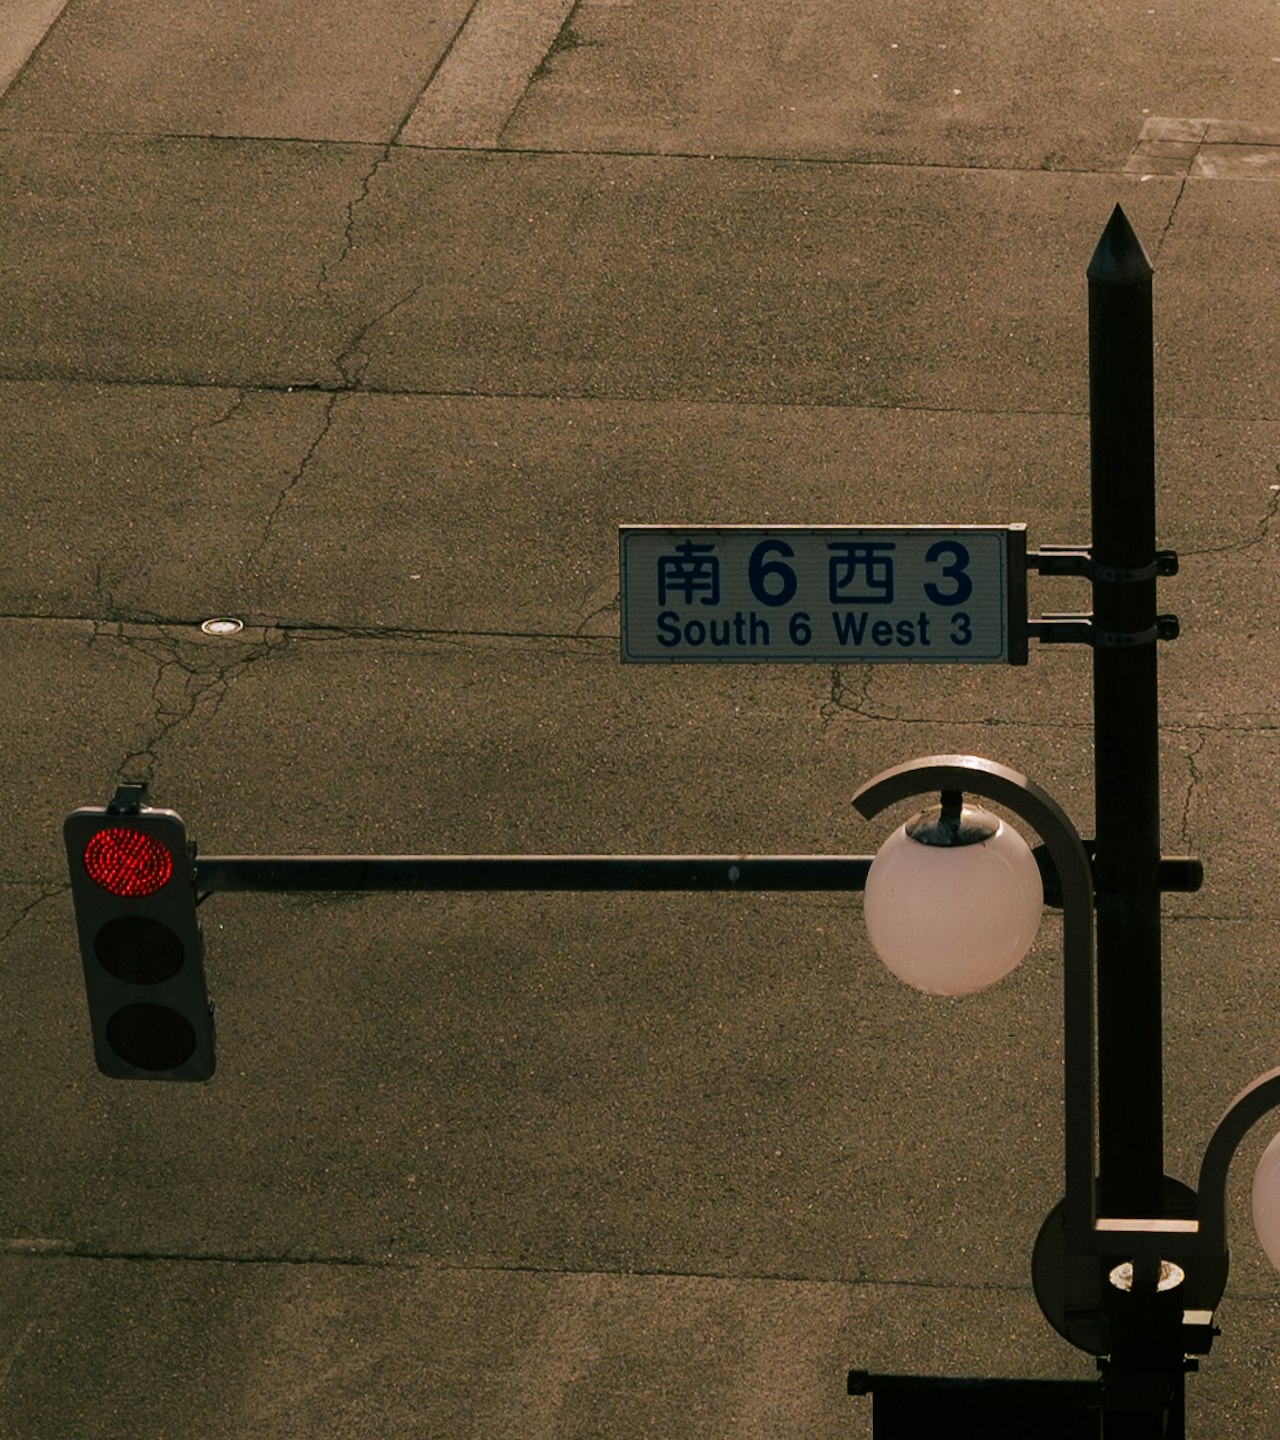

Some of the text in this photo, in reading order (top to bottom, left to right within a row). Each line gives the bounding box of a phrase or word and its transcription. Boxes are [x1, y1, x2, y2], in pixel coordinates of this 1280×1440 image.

[658, 539, 972, 607] 南6西3
[657, 612, 972, 647] South 6 West 3
